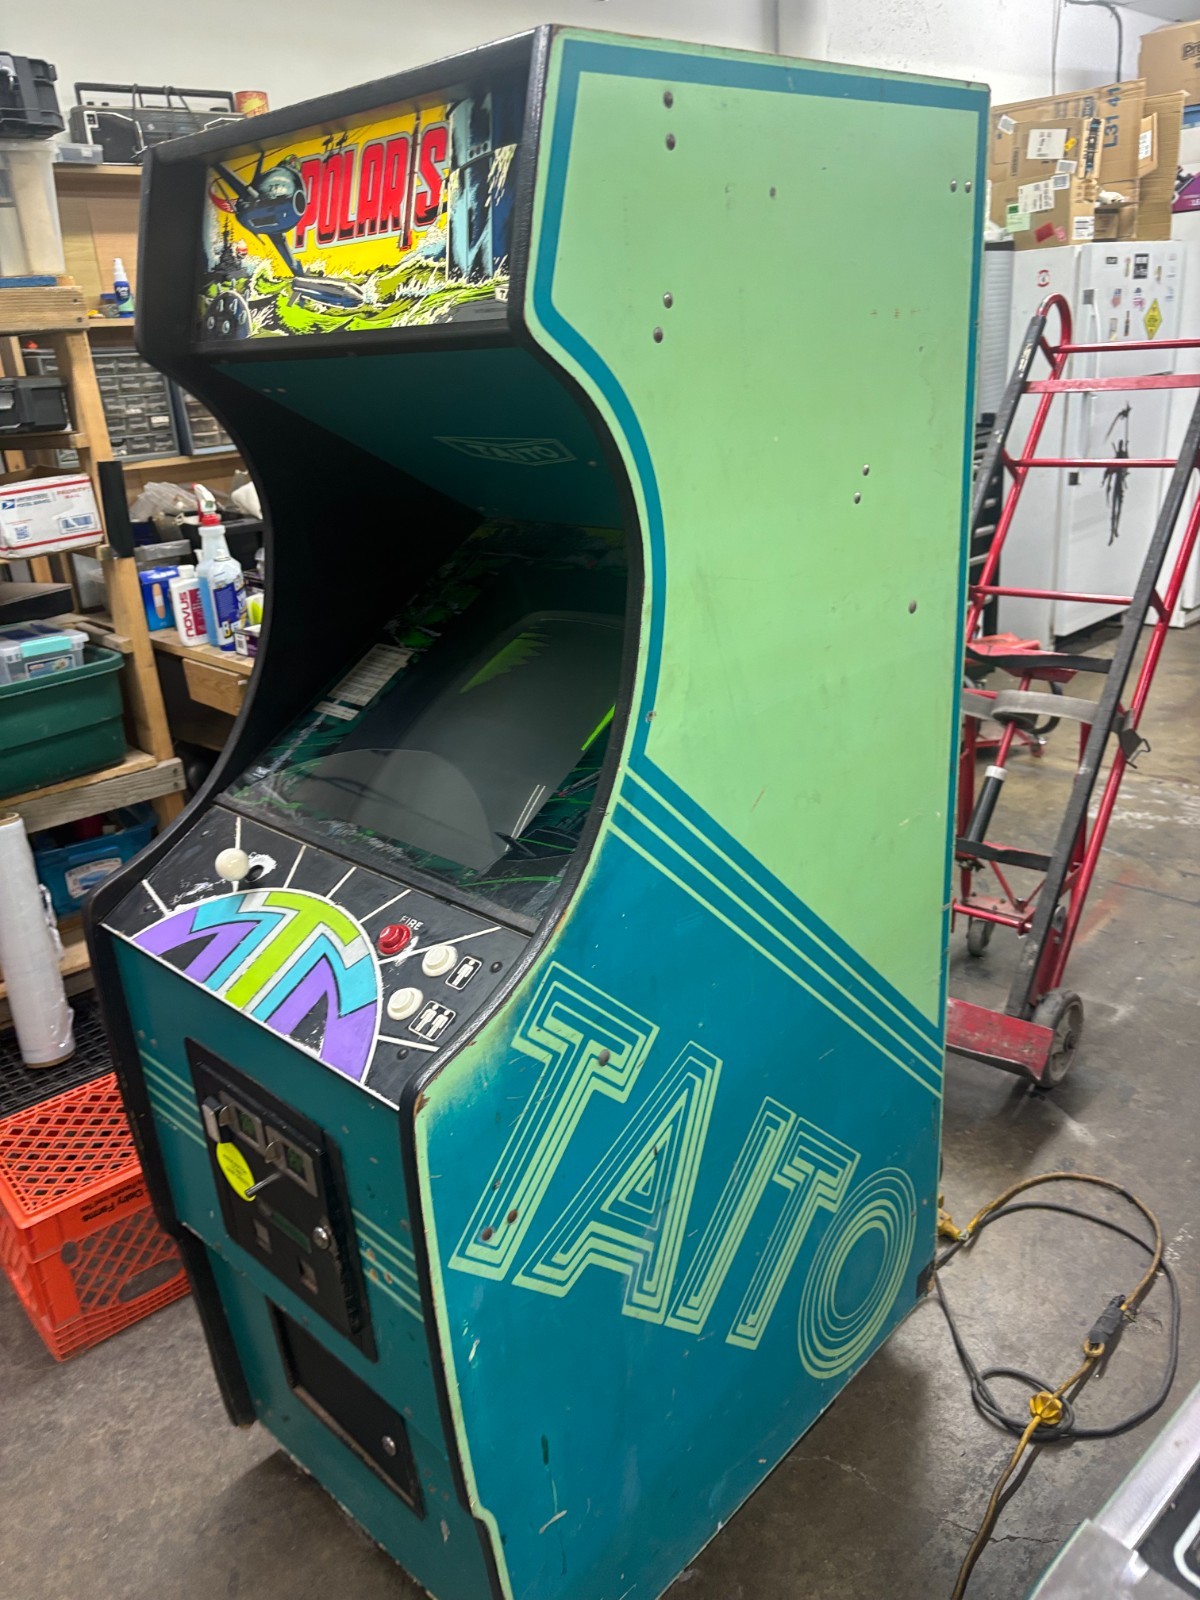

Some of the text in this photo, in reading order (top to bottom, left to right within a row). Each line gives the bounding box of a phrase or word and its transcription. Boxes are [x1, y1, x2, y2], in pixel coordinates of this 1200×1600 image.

[294, 122, 449, 251] POLARIS
[399, 915, 424, 931] FIRE
[447, 961, 918, 1380] TAITO
